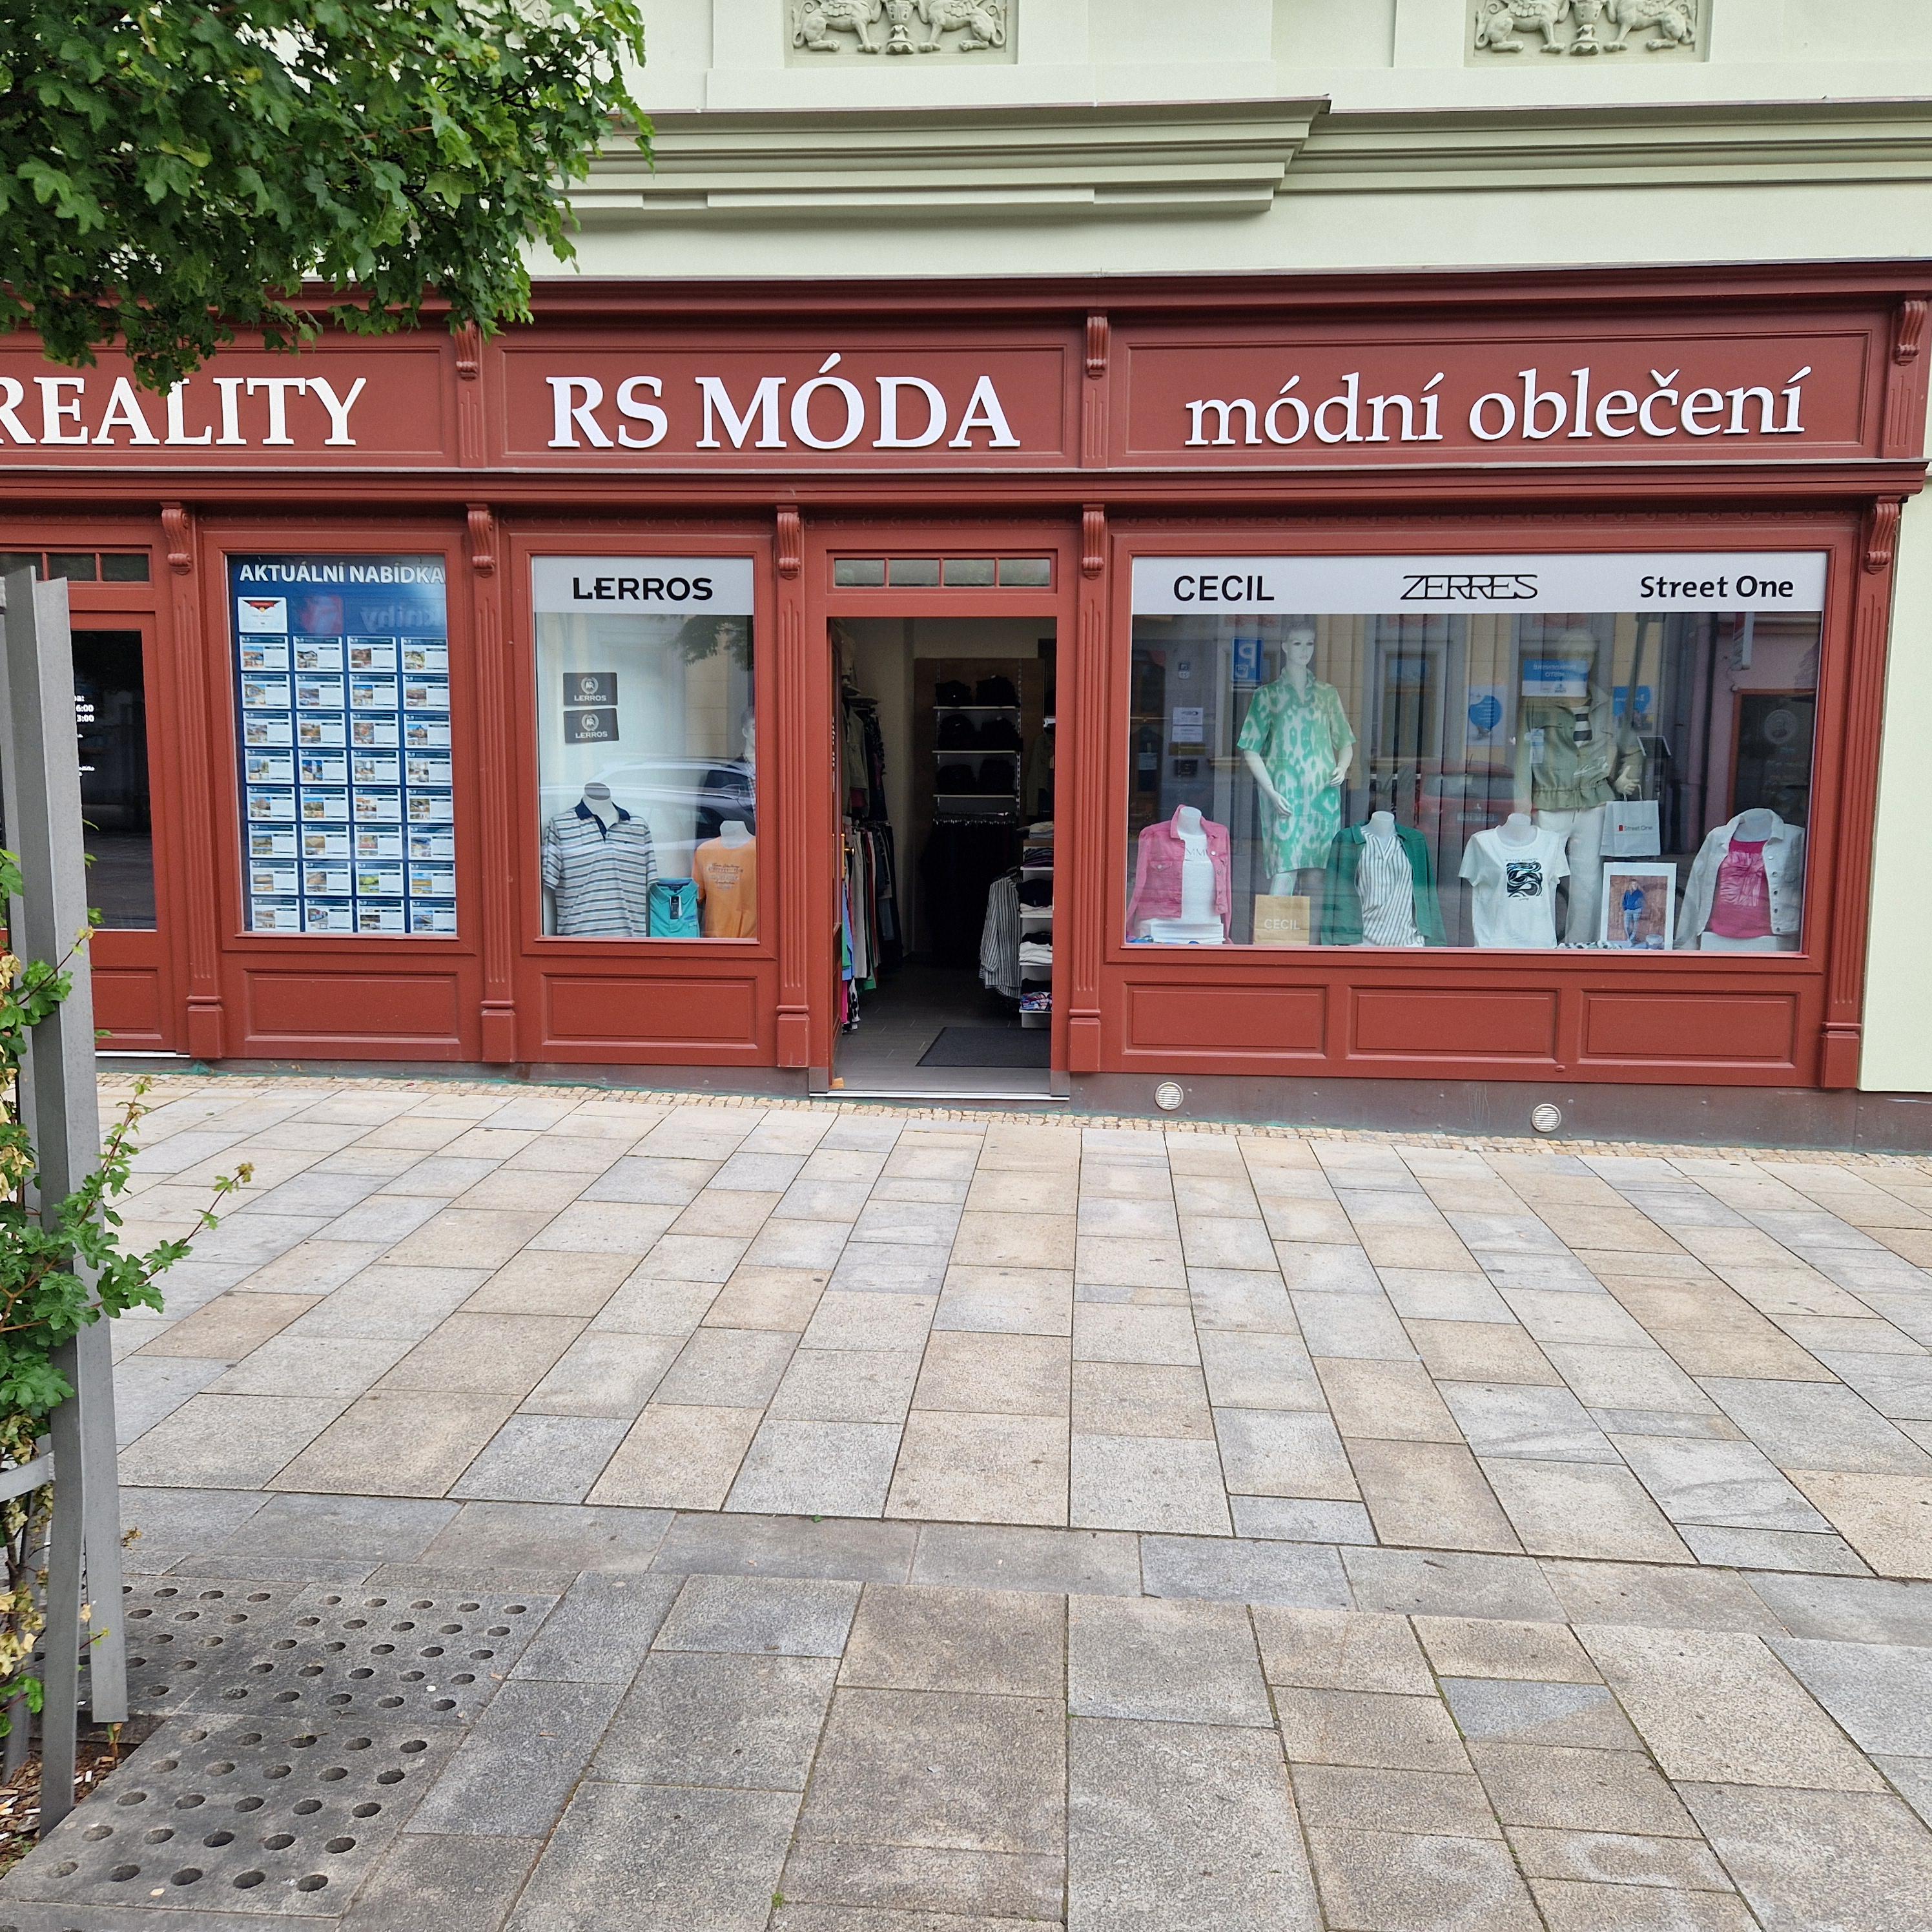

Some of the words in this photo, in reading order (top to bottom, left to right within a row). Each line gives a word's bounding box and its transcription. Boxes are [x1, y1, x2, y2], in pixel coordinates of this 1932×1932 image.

[0, 376, 367, 446] REALITY
[546, 376, 668, 448] RS
[695, 353, 1021, 449] MÓDA
[1185, 371, 1444, 446] módní
[1469, 365, 1811, 441] oblečení
[240, 561, 344, 582] AKTUÁLNÍ
[349, 562, 445, 584] NABÍDKA
[573, 577, 713, 601] LERROS
[1173, 575, 1275, 602] CECIL
[1400, 574, 1538, 601] ZERRES
[1640, 576, 1729, 598] Street
[1736, 575, 1794, 598] One
[76, 704, 94, 712] 6:00
[77, 714, 95, 723] 3:00
[1264, 919, 1300, 930] CECIL
